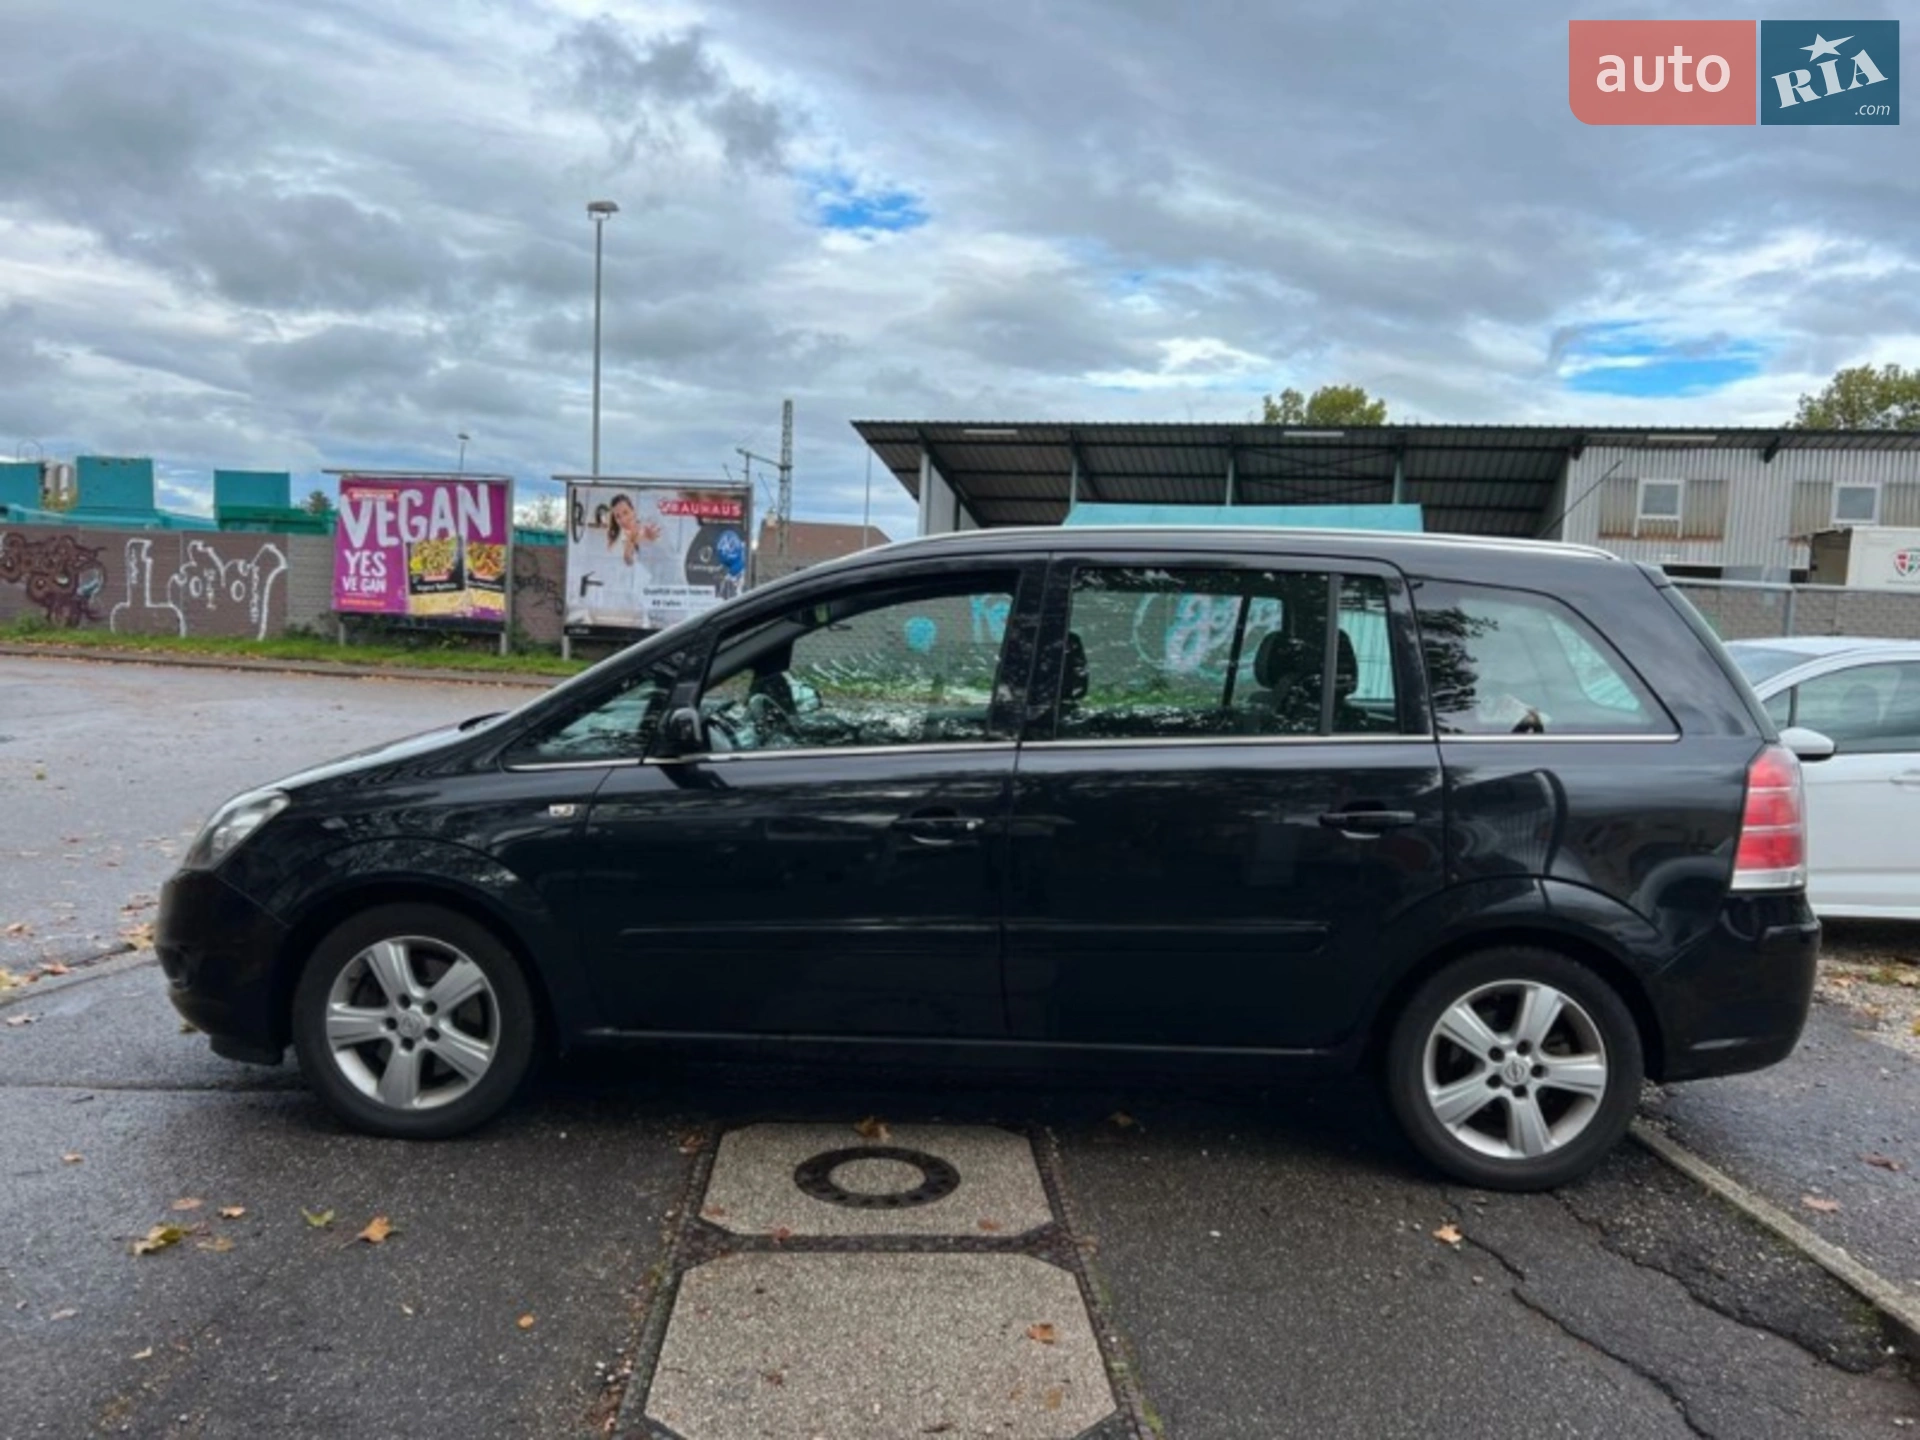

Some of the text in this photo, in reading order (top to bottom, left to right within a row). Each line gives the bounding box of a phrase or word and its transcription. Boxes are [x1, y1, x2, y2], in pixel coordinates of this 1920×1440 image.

[340, 483, 492, 549] VEGAN
[671, 502, 742, 517] BAUHAUS
[344, 550, 387, 577] YES
